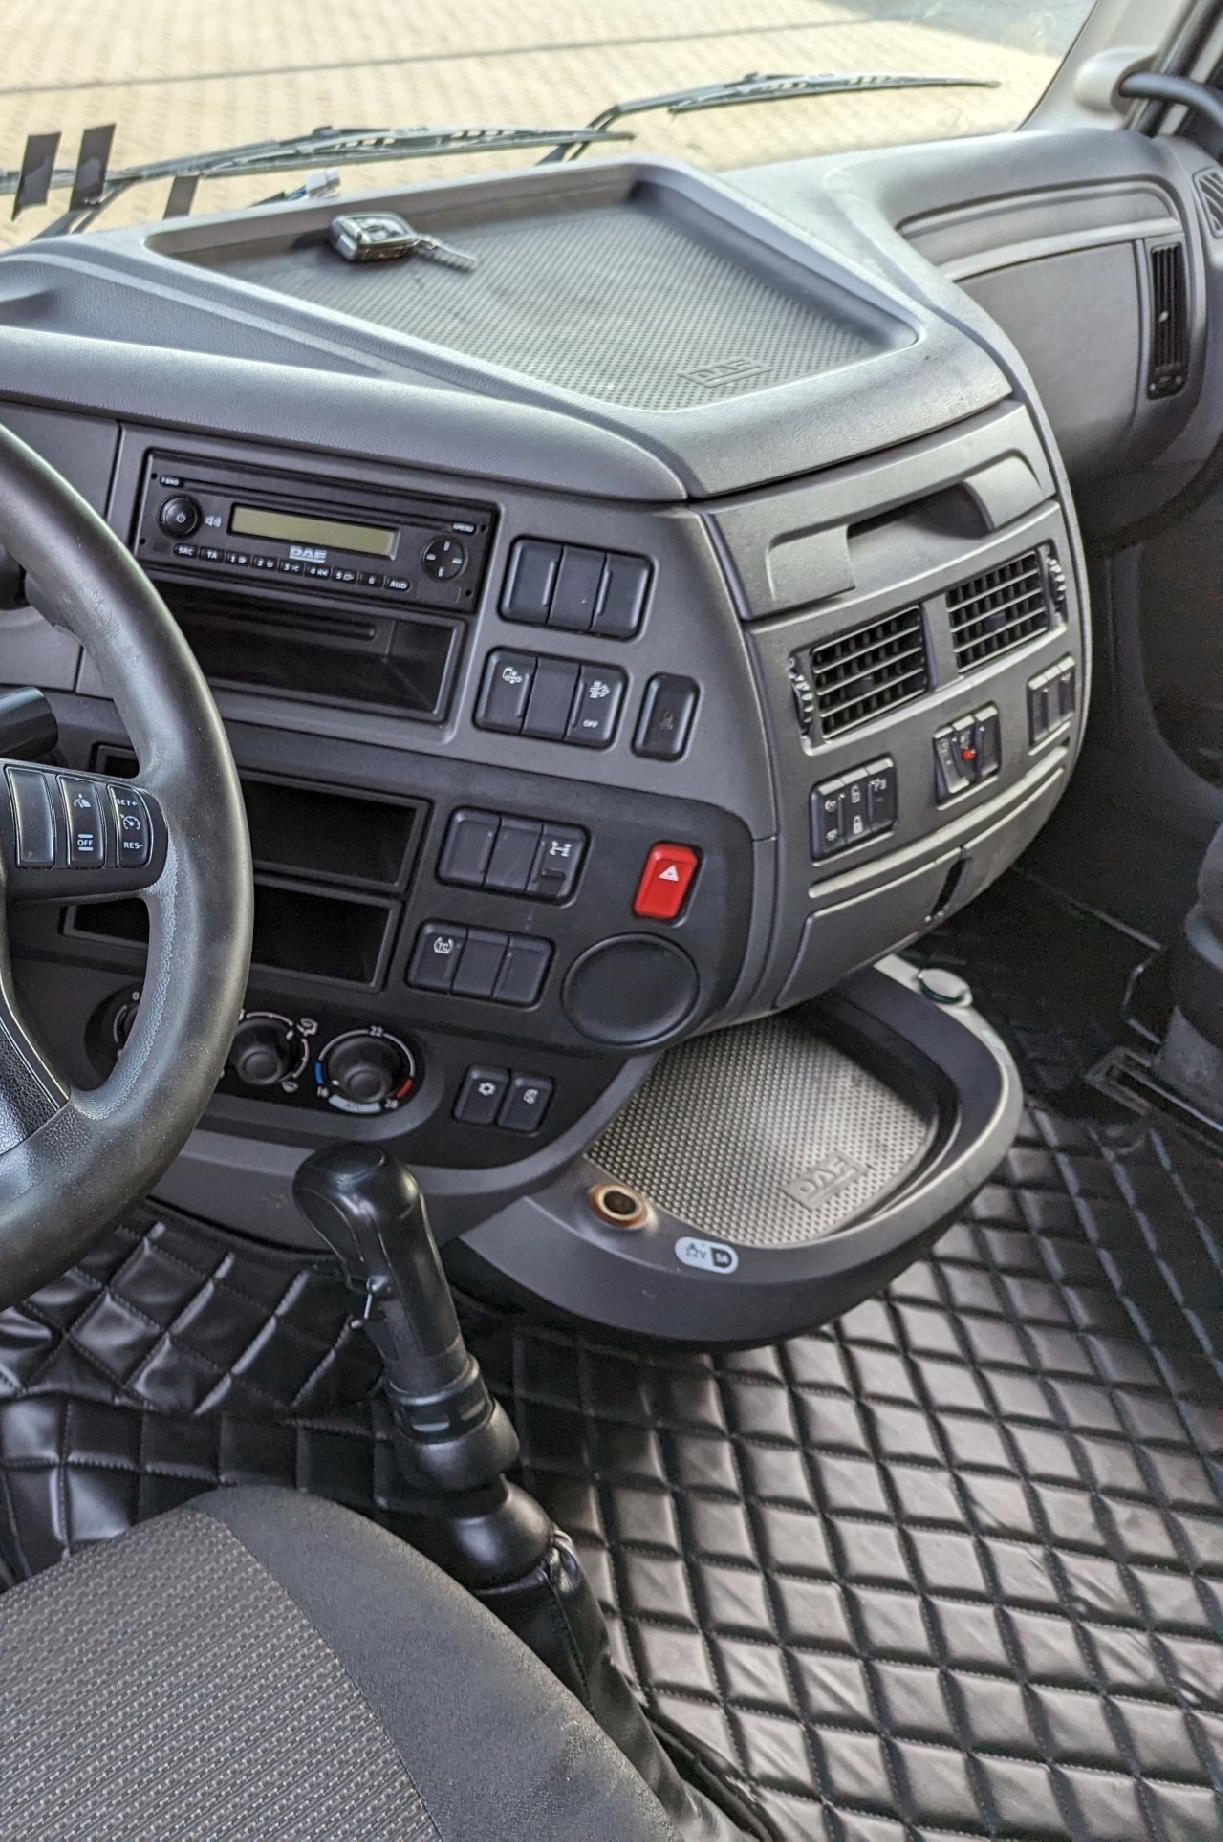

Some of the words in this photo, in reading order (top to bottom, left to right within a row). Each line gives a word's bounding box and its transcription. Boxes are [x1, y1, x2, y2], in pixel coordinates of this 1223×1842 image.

[290, 545, 327, 561] DAF
[370, 1026, 383, 1037] 22
[795, 1158, 846, 1195] DAF
